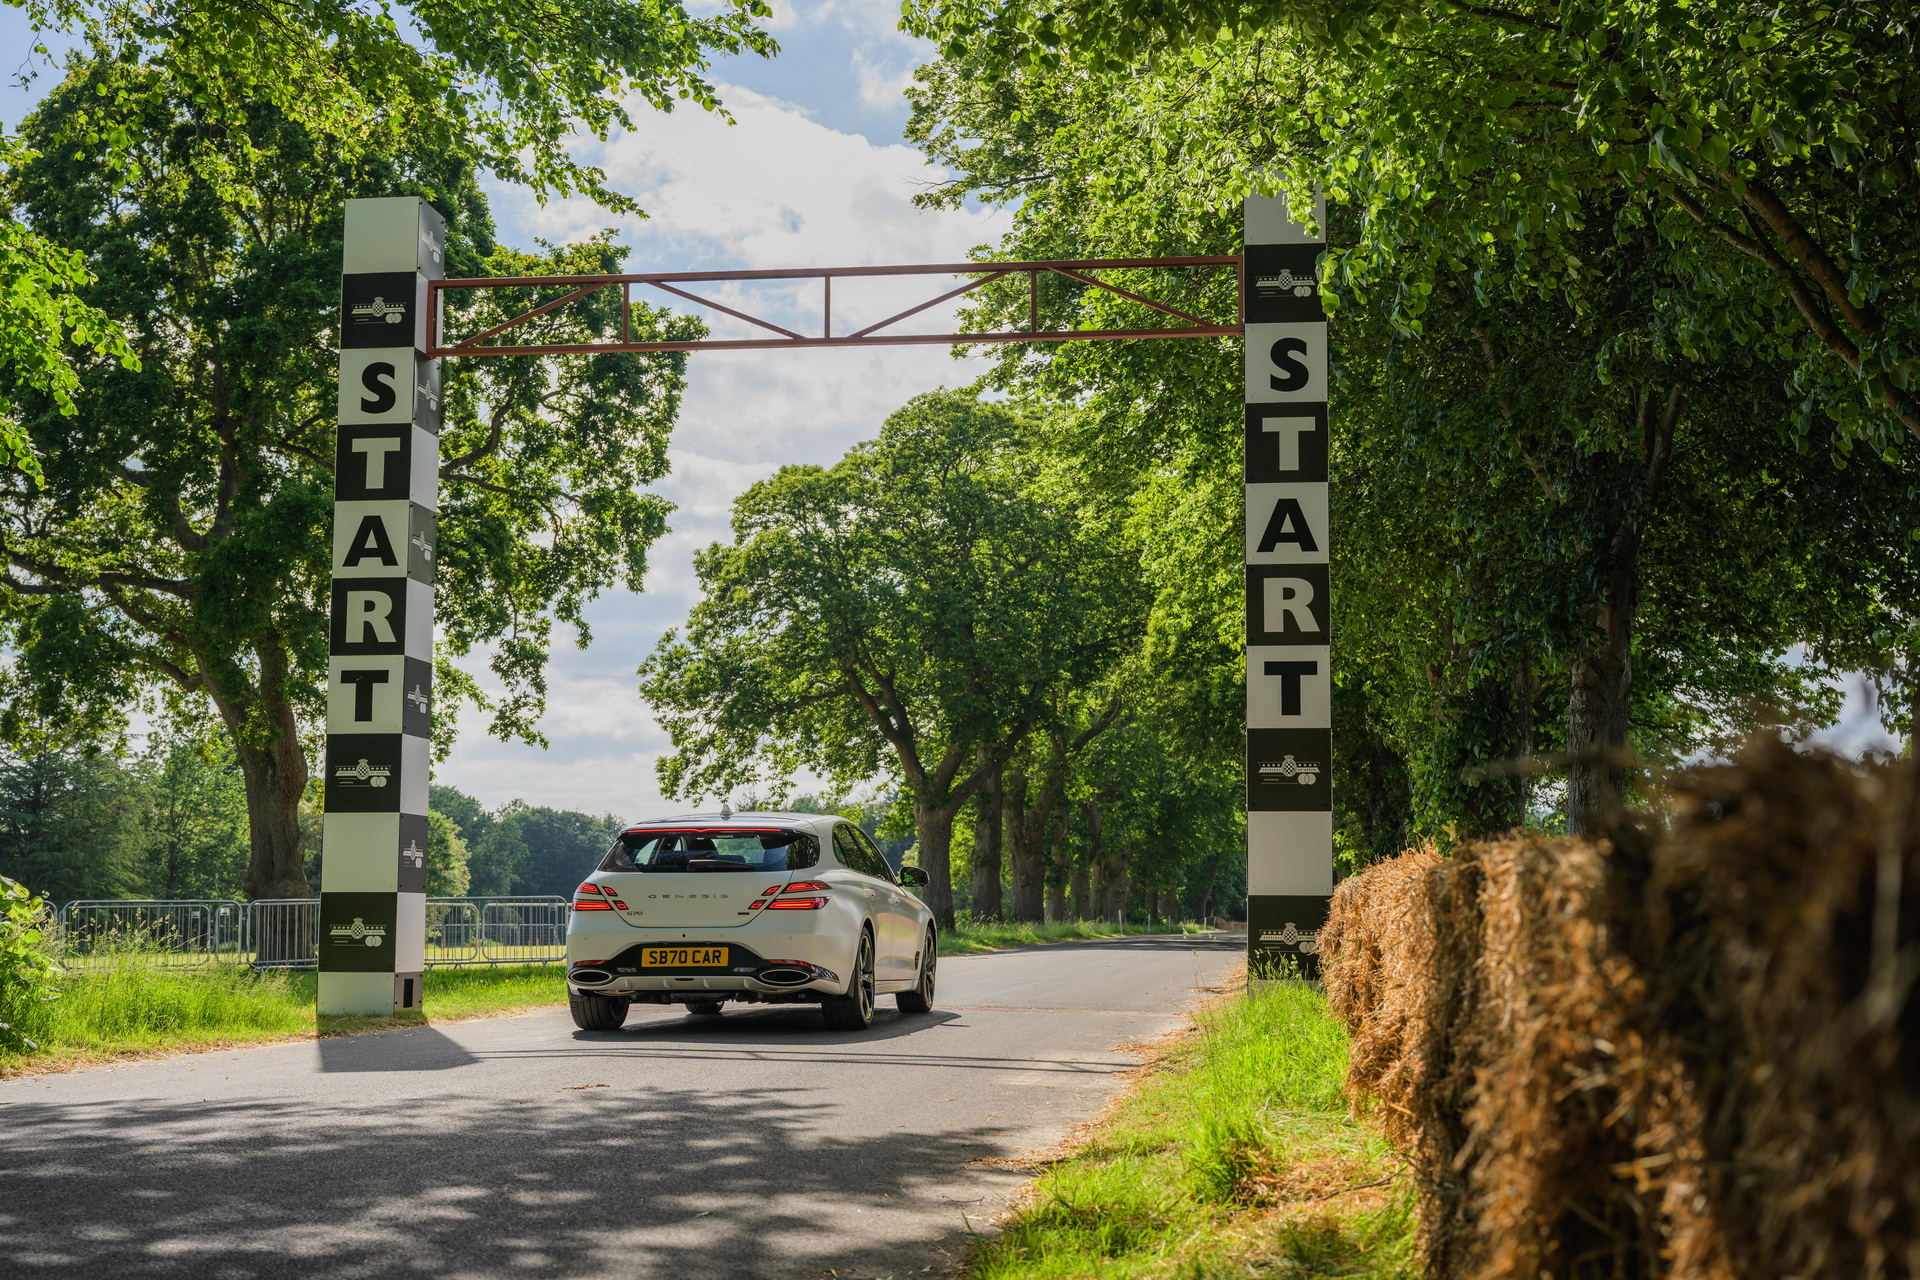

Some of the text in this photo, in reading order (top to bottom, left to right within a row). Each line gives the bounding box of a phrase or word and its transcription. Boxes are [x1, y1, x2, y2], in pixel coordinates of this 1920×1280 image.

[340, 361, 401, 722] START
[1256, 337, 1321, 716] START
[649, 950, 722, 965] SB70 CAR
